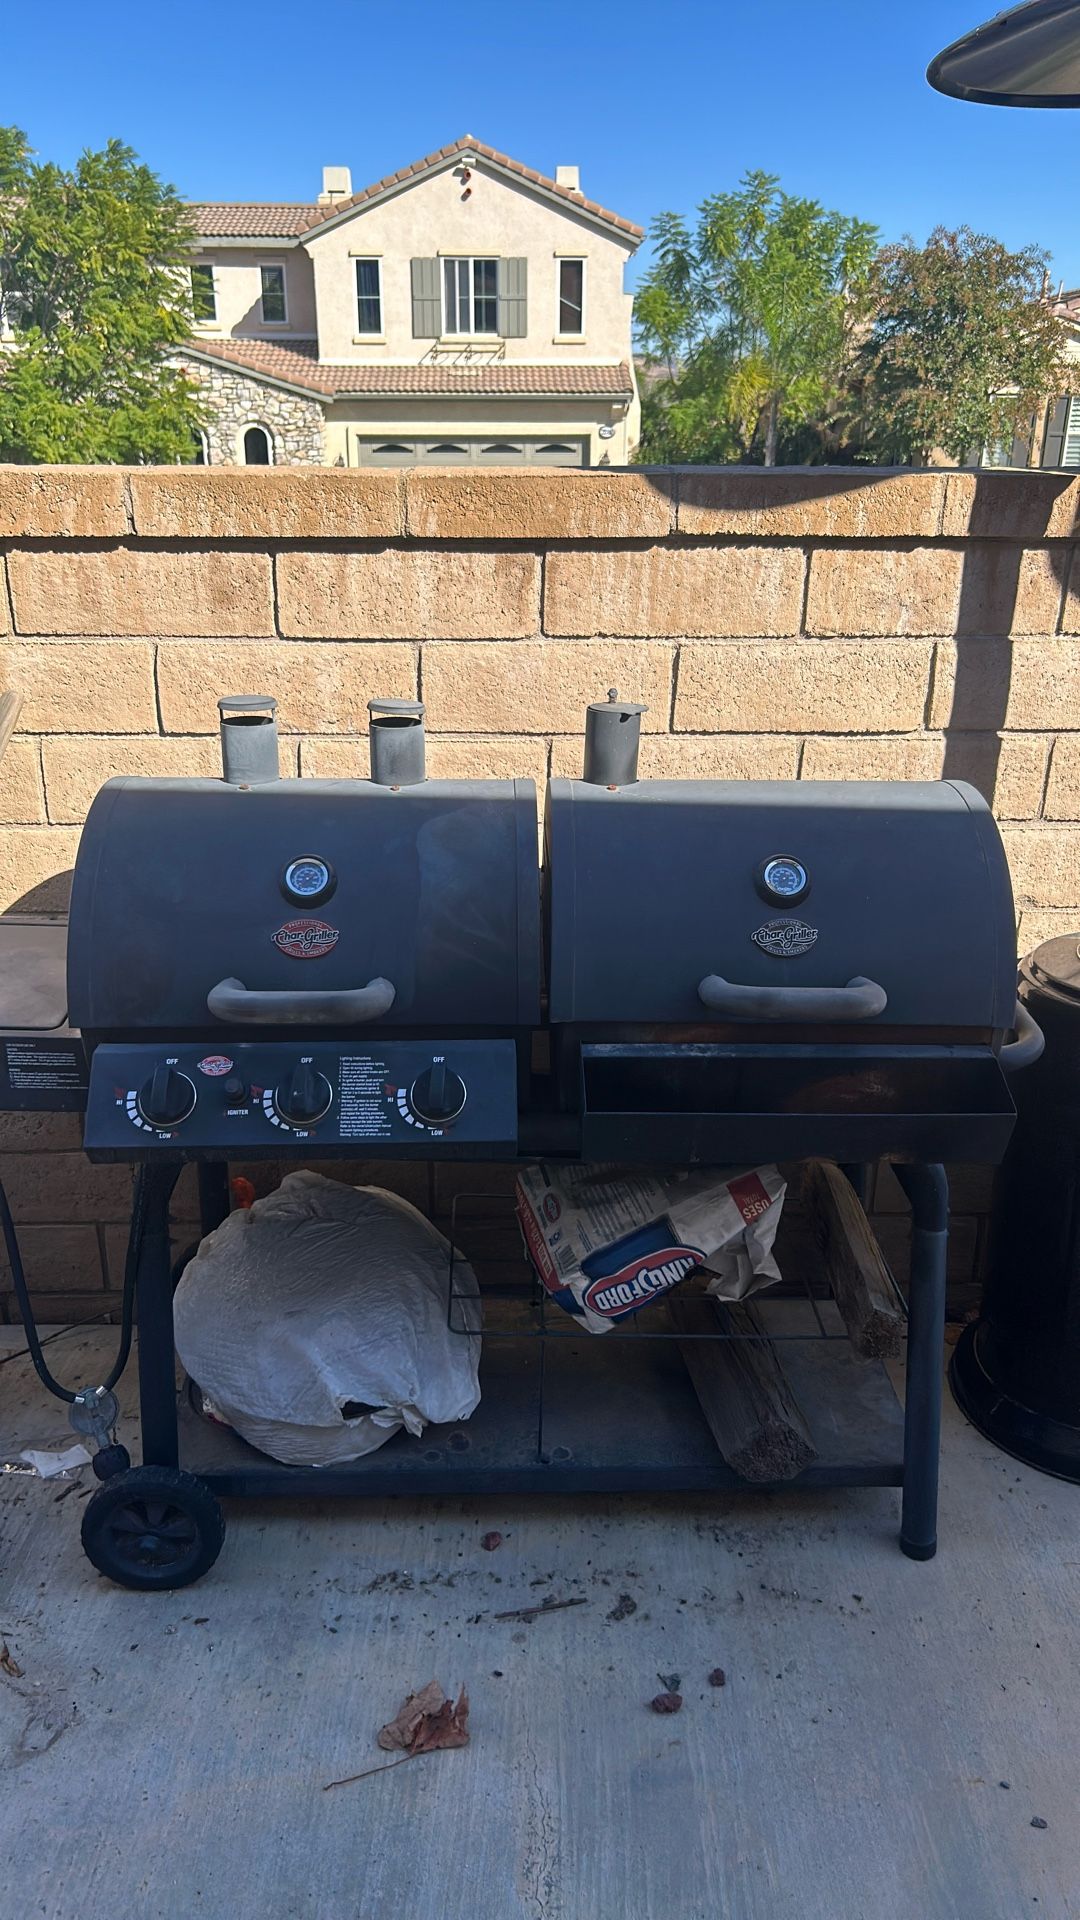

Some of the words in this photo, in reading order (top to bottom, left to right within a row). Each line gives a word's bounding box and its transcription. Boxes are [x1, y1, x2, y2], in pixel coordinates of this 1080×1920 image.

[271, 927, 340, 951] Char-Griller
[751, 926, 819, 950] Char-Griller
[742, 1199, 770, 1219] USES
